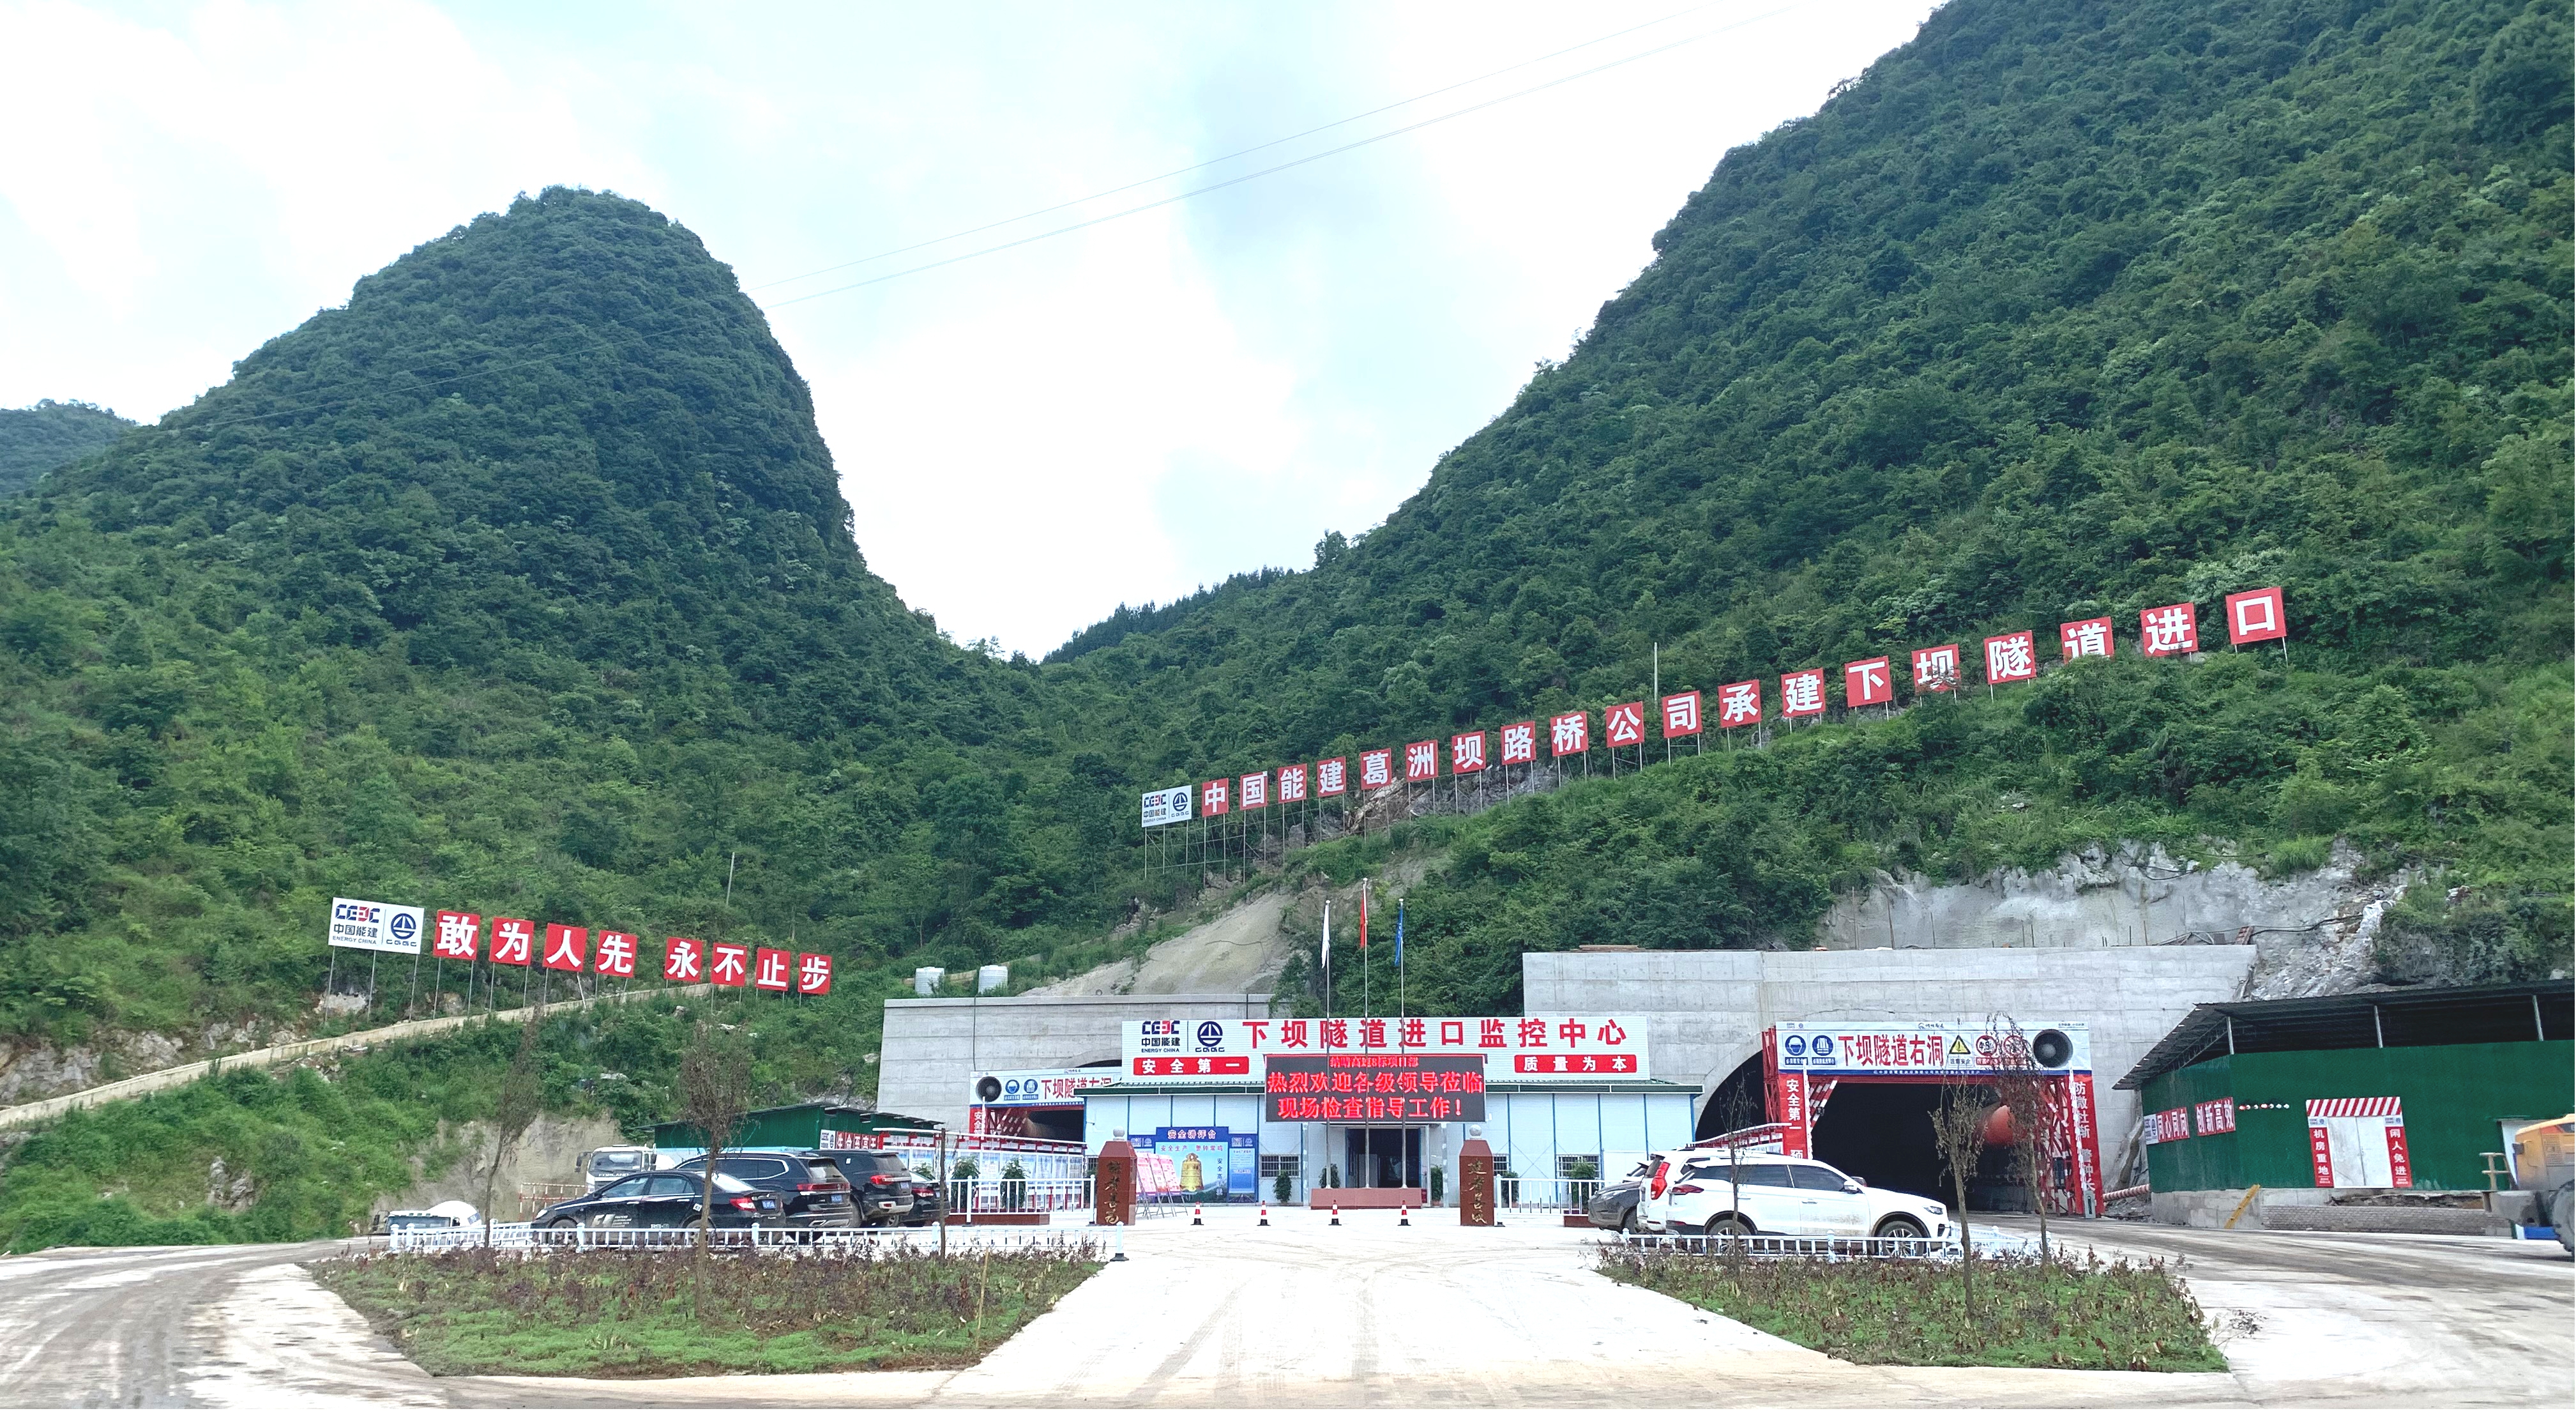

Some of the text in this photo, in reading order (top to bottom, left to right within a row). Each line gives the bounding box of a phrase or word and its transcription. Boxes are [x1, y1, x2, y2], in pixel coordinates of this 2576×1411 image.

[1205, 595, 2276, 814] 中国能建葛洲坝路桥公司承建下坝隧道进口
[333, 924, 378, 938] 中国能建
[437, 914, 830, 991] 敢为人先 永不止步
[1141, 1037, 1180, 1047] 中国能建
[1242, 1018, 1627, 1049] 下坝隧道进口监控中心
[1141, 1058, 1240, 1074] 安全第一
[1524, 1055, 1628, 1072] 质量为本
[1838, 1033, 1944, 1067] 下坝隧道右洞
[1267, 1071, 1483, 1094] 热烈欢迎各级领导莅临
[1786, 1079, 1802, 1130] 安全第一
[2314, 1129, 2330, 1176] 机房重地
[2390, 1129, 2407, 1176] 闲人免进
